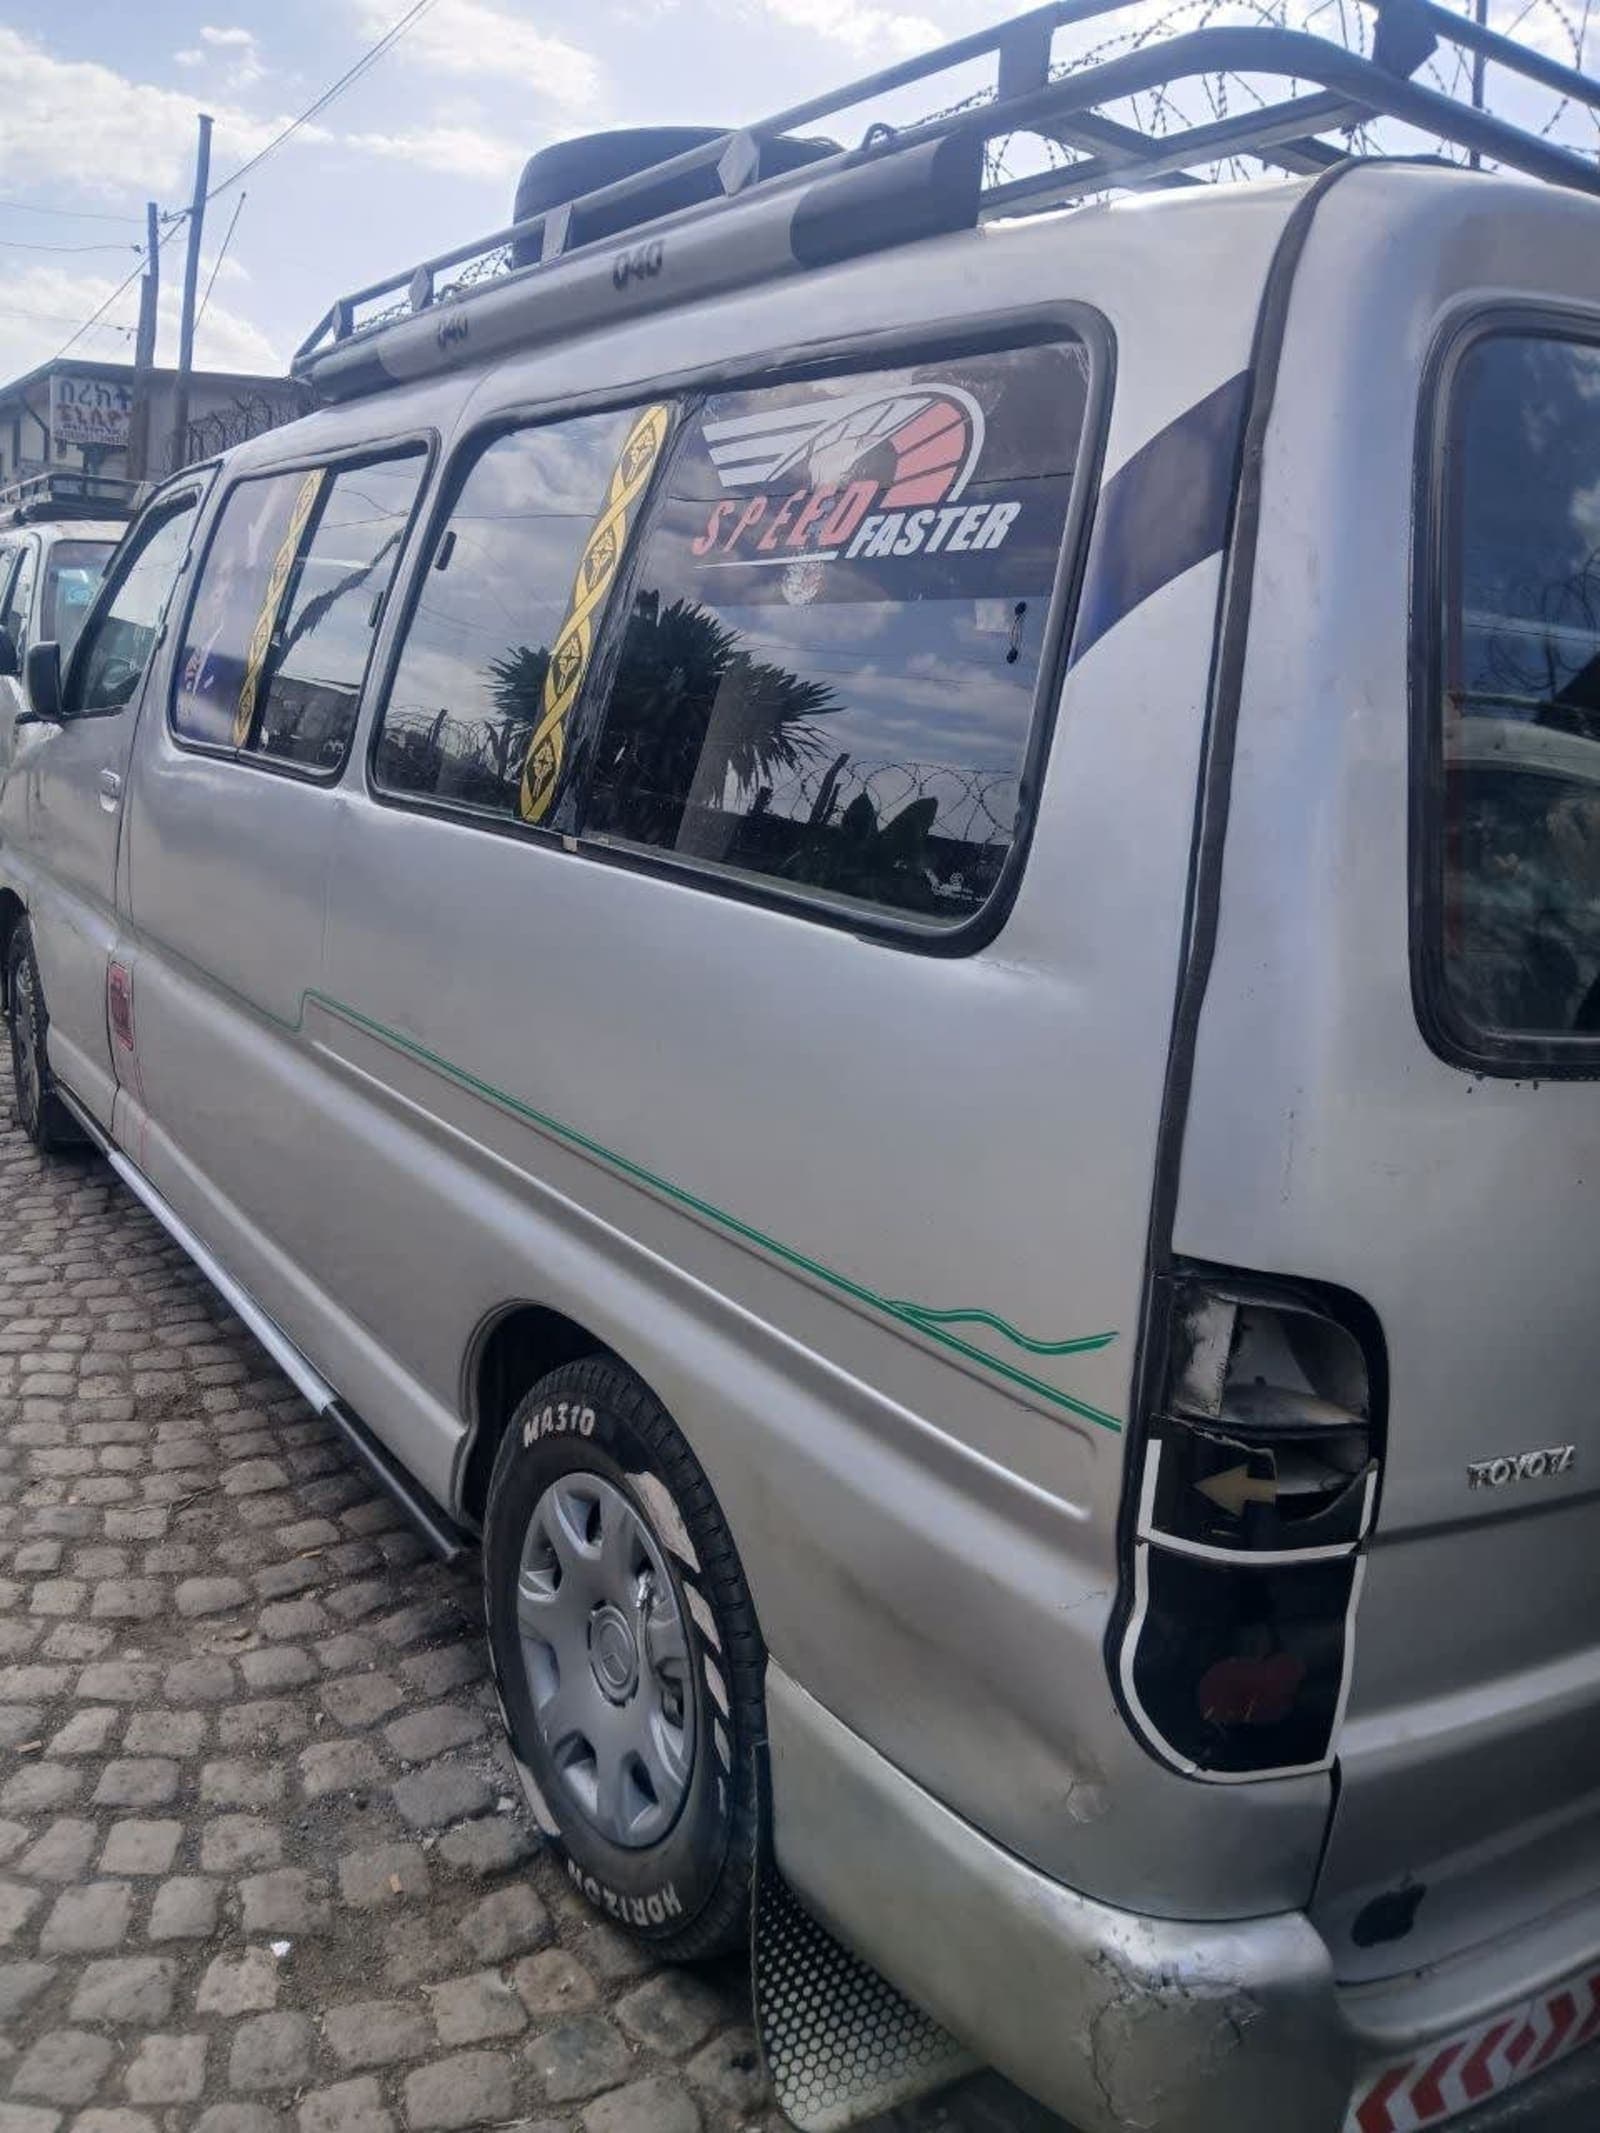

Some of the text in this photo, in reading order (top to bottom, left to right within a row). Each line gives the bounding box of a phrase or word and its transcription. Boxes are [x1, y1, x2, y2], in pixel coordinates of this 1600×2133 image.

[691, 480, 1021, 559] SPEED FASTER
[1467, 1445, 1576, 1489] TOYOTA
